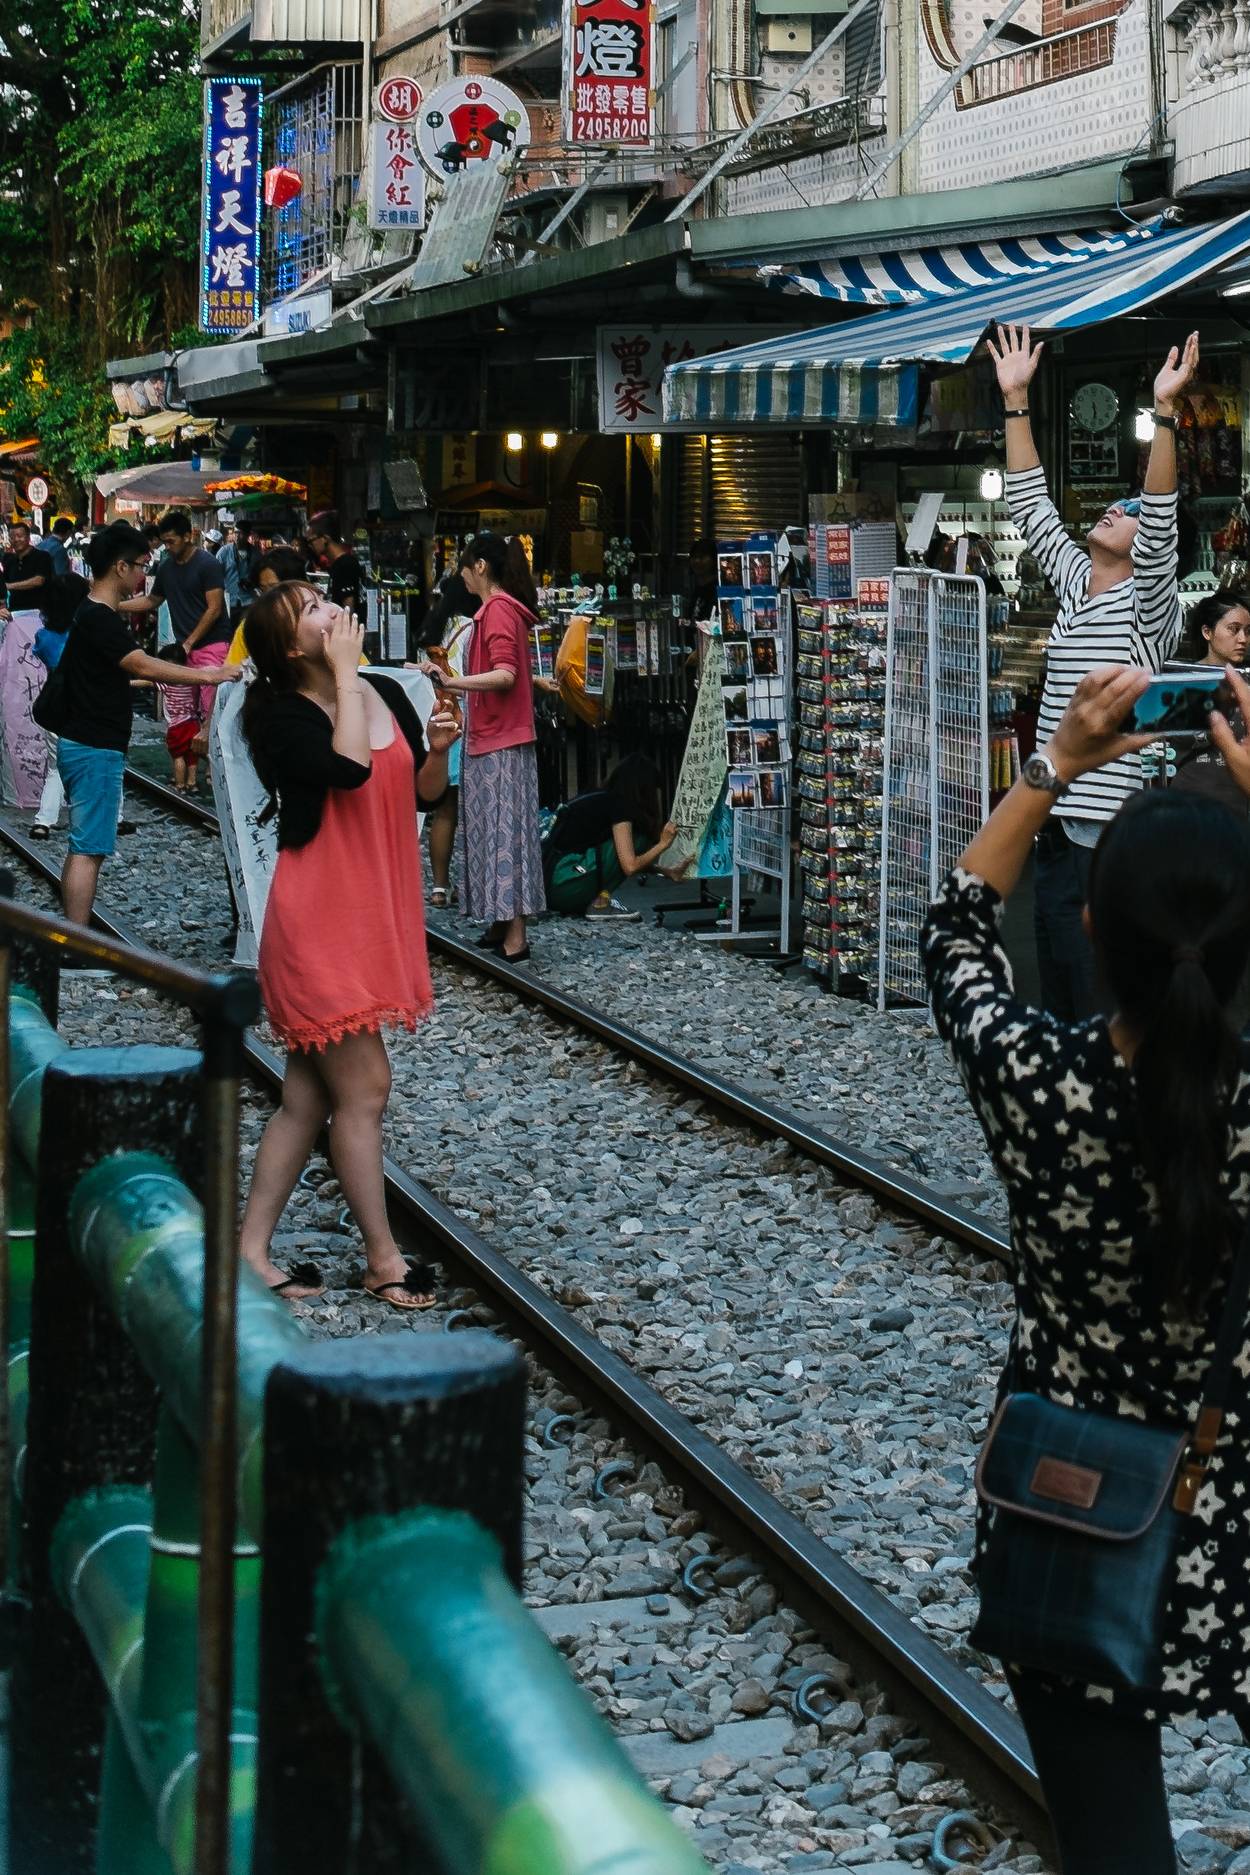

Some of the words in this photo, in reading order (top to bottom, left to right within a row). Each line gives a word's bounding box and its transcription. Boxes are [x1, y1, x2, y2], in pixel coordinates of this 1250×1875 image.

[388, 85, 412, 113] 胡
[577, 85, 647, 115] 批發零售
[577, 116, 647, 140] 24958209
[386, 127, 414, 206] 你會紅
[213, 85, 252, 287] 吉祥天燈
[378, 209, 420, 224] 天燈精品
[611, 334, 656, 422] 曾家
